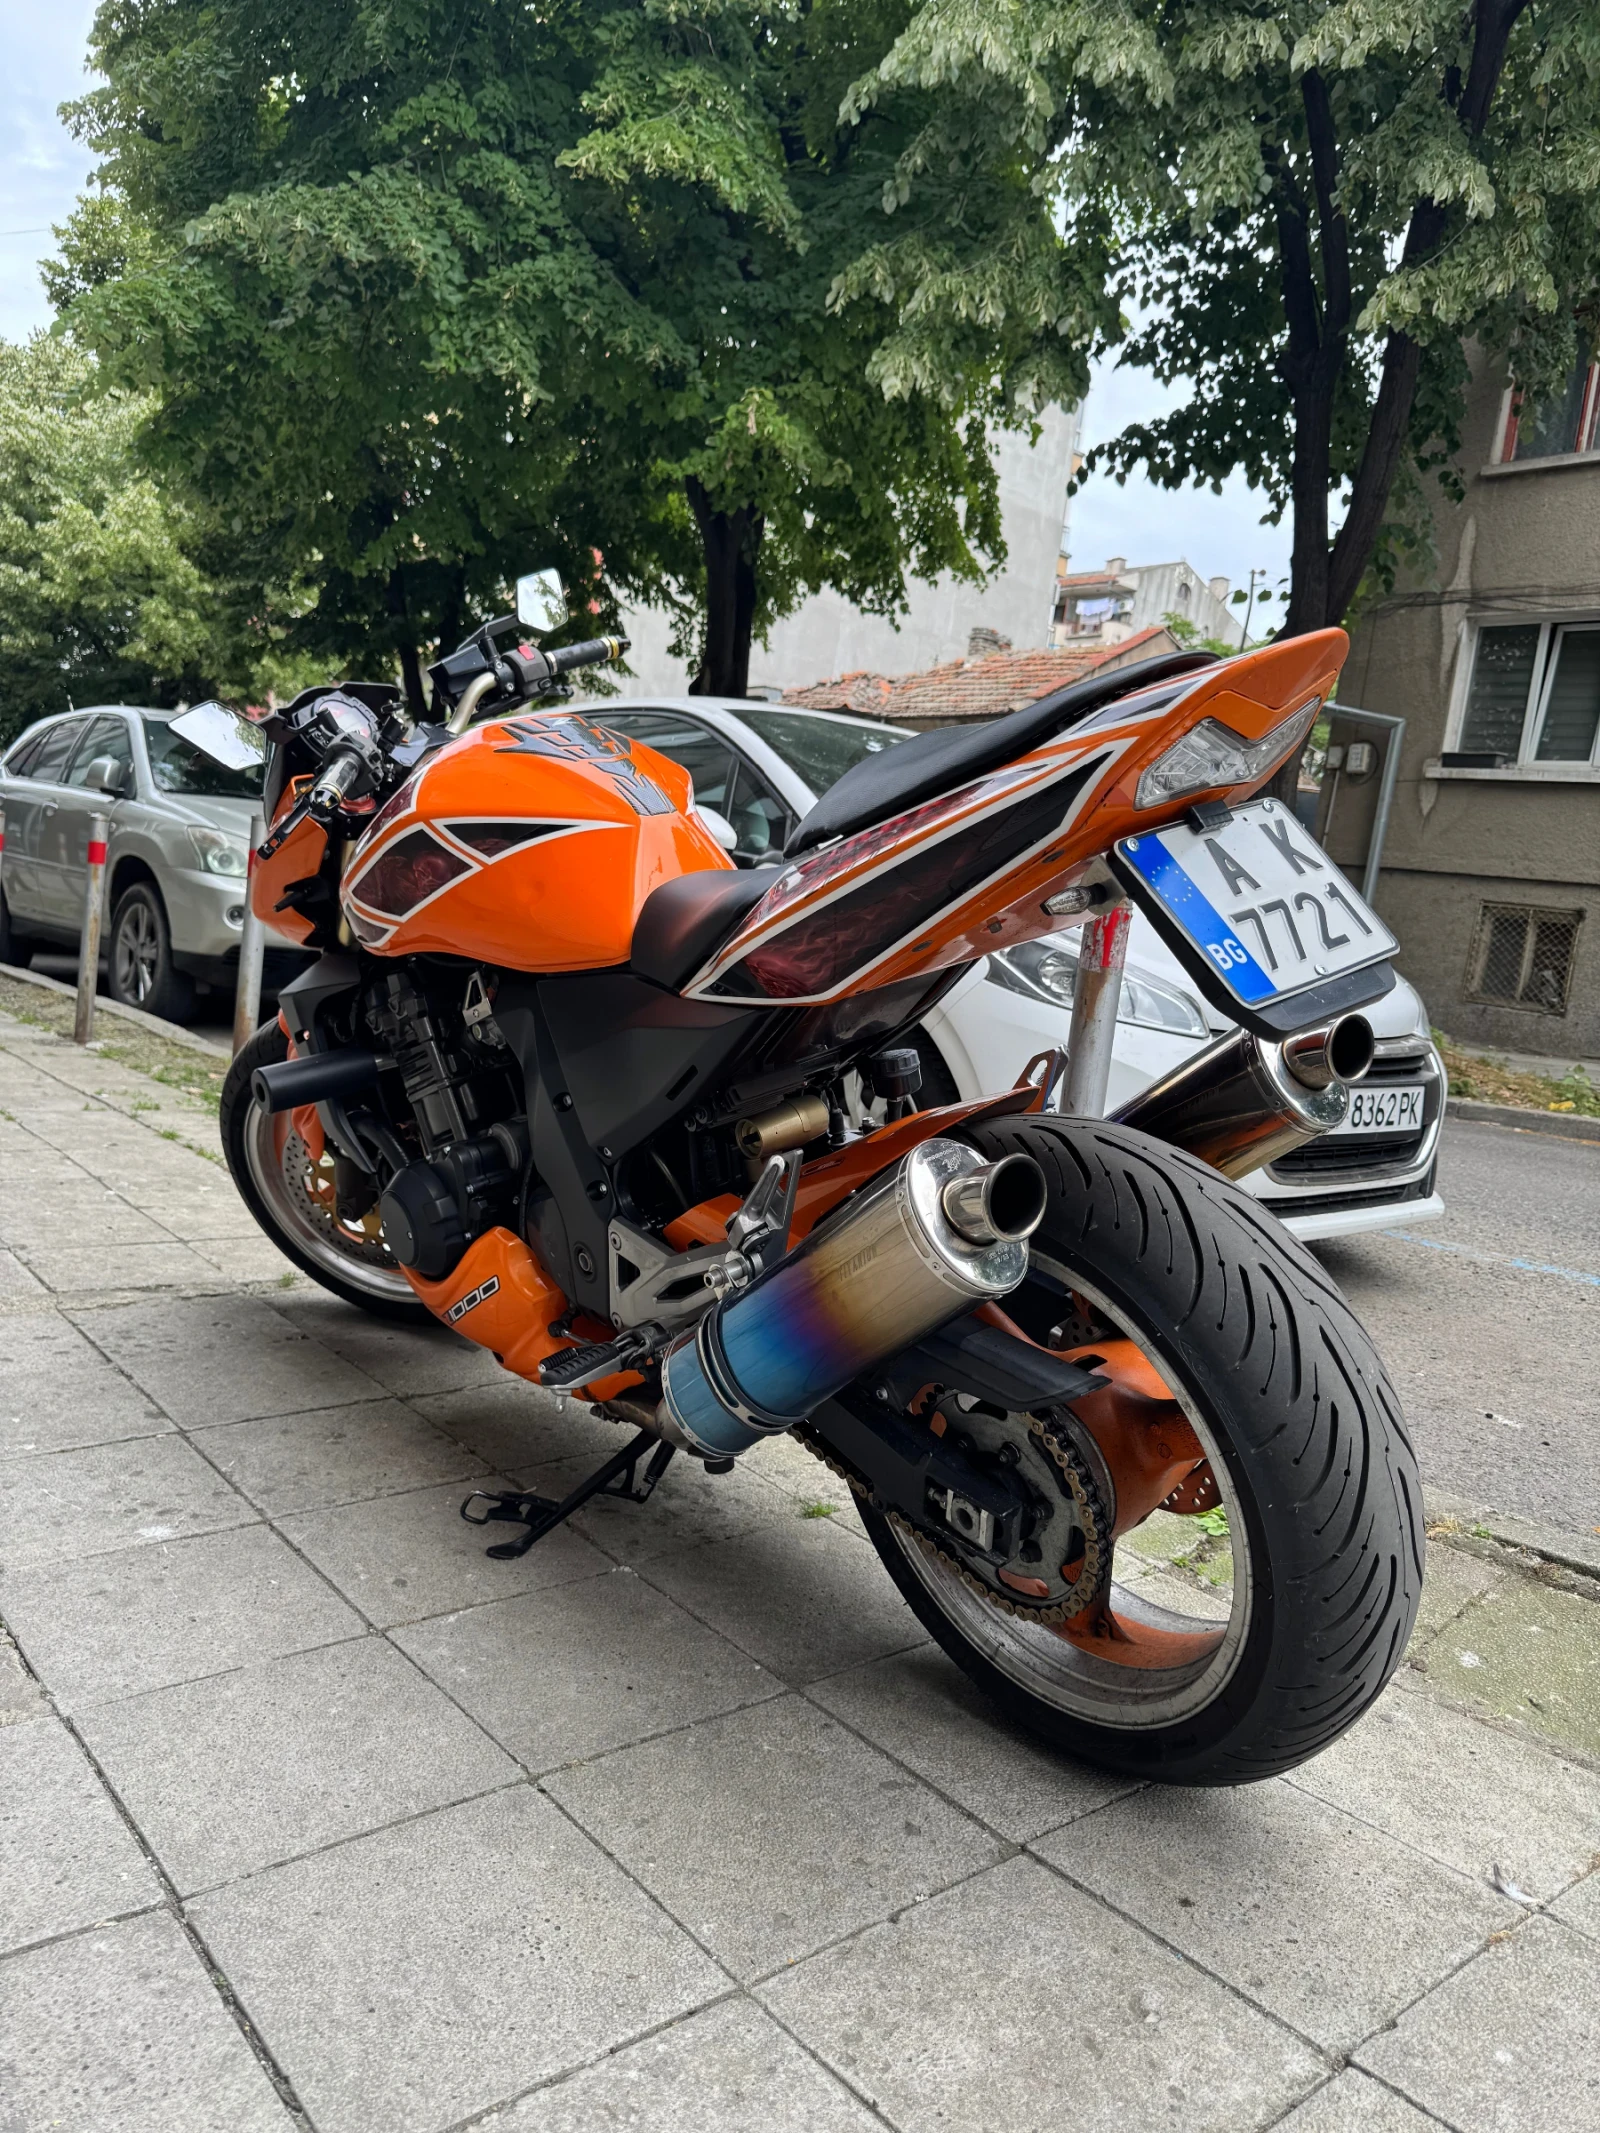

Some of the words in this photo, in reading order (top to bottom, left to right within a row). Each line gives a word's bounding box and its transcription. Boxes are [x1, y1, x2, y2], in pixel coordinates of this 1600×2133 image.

[1204, 838, 1262, 897] A
[1258, 819, 1324, 876] K
[1206, 937, 1248, 971] BG
[1229, 881, 1374, 973] 7721
